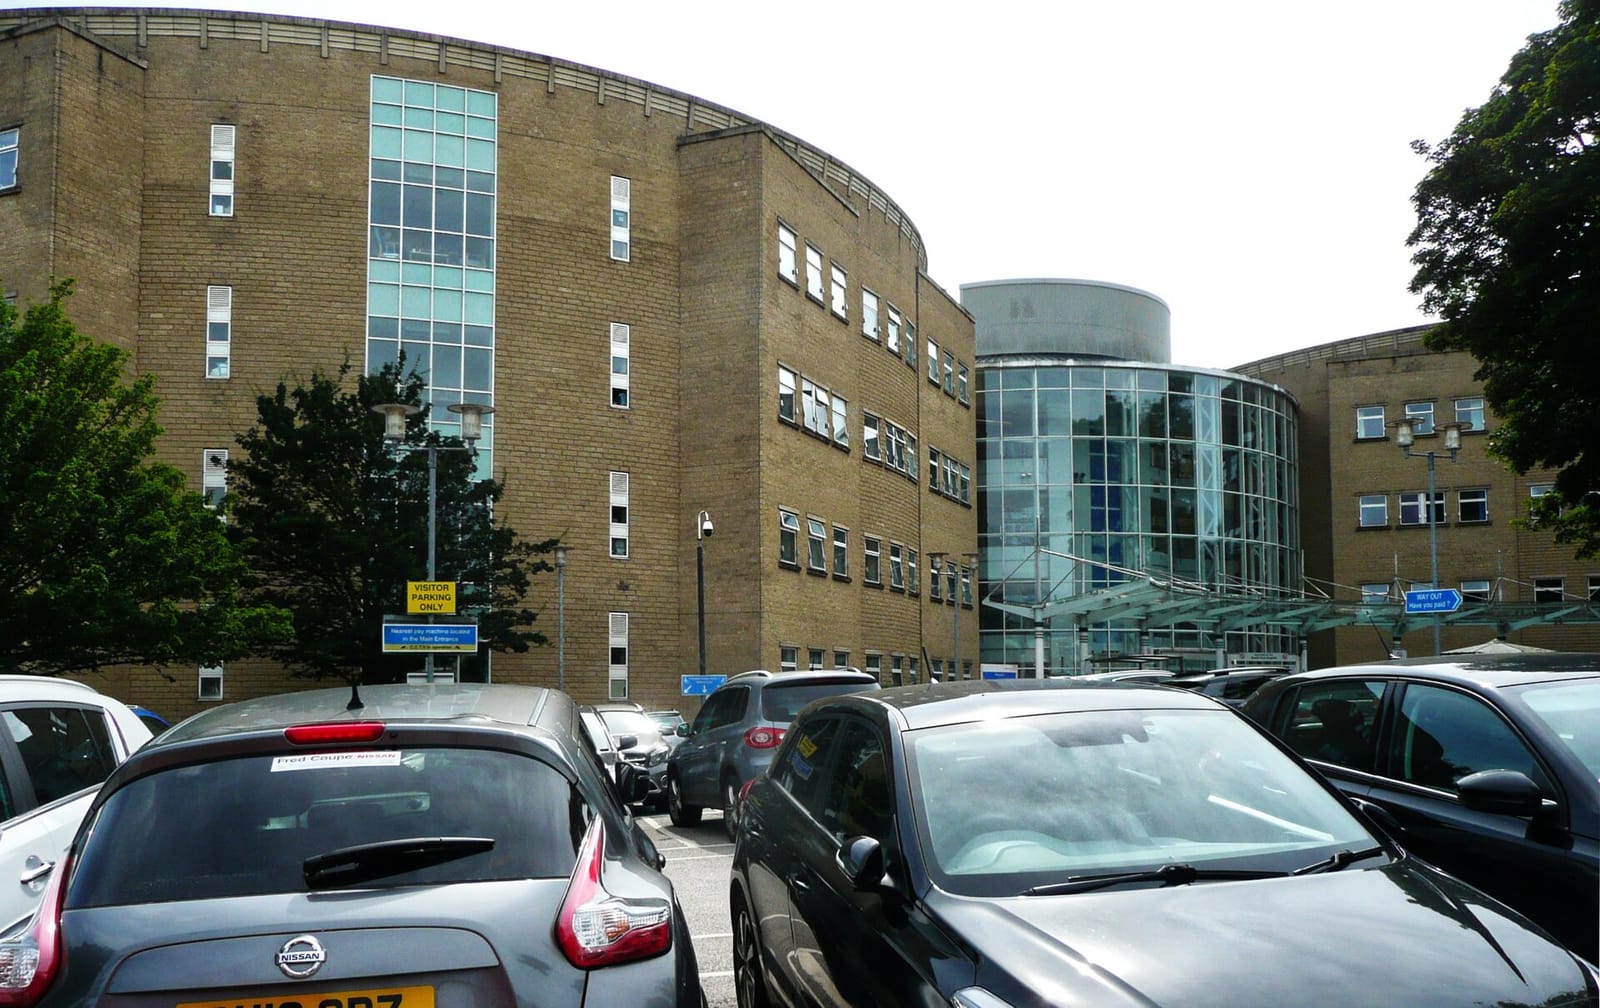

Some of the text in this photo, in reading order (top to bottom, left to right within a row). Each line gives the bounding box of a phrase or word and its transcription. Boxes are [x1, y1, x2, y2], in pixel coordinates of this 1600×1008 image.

[414, 583, 449, 592] VISITOR
[411, 593, 452, 601] PARKING
[1430, 592, 1442, 600] OUT
[419, 603, 444, 611] ONLY
[1423, 602, 1433, 610] you
[277, 756, 306, 764] Fred
[281, 952, 320, 961] NISSAN
